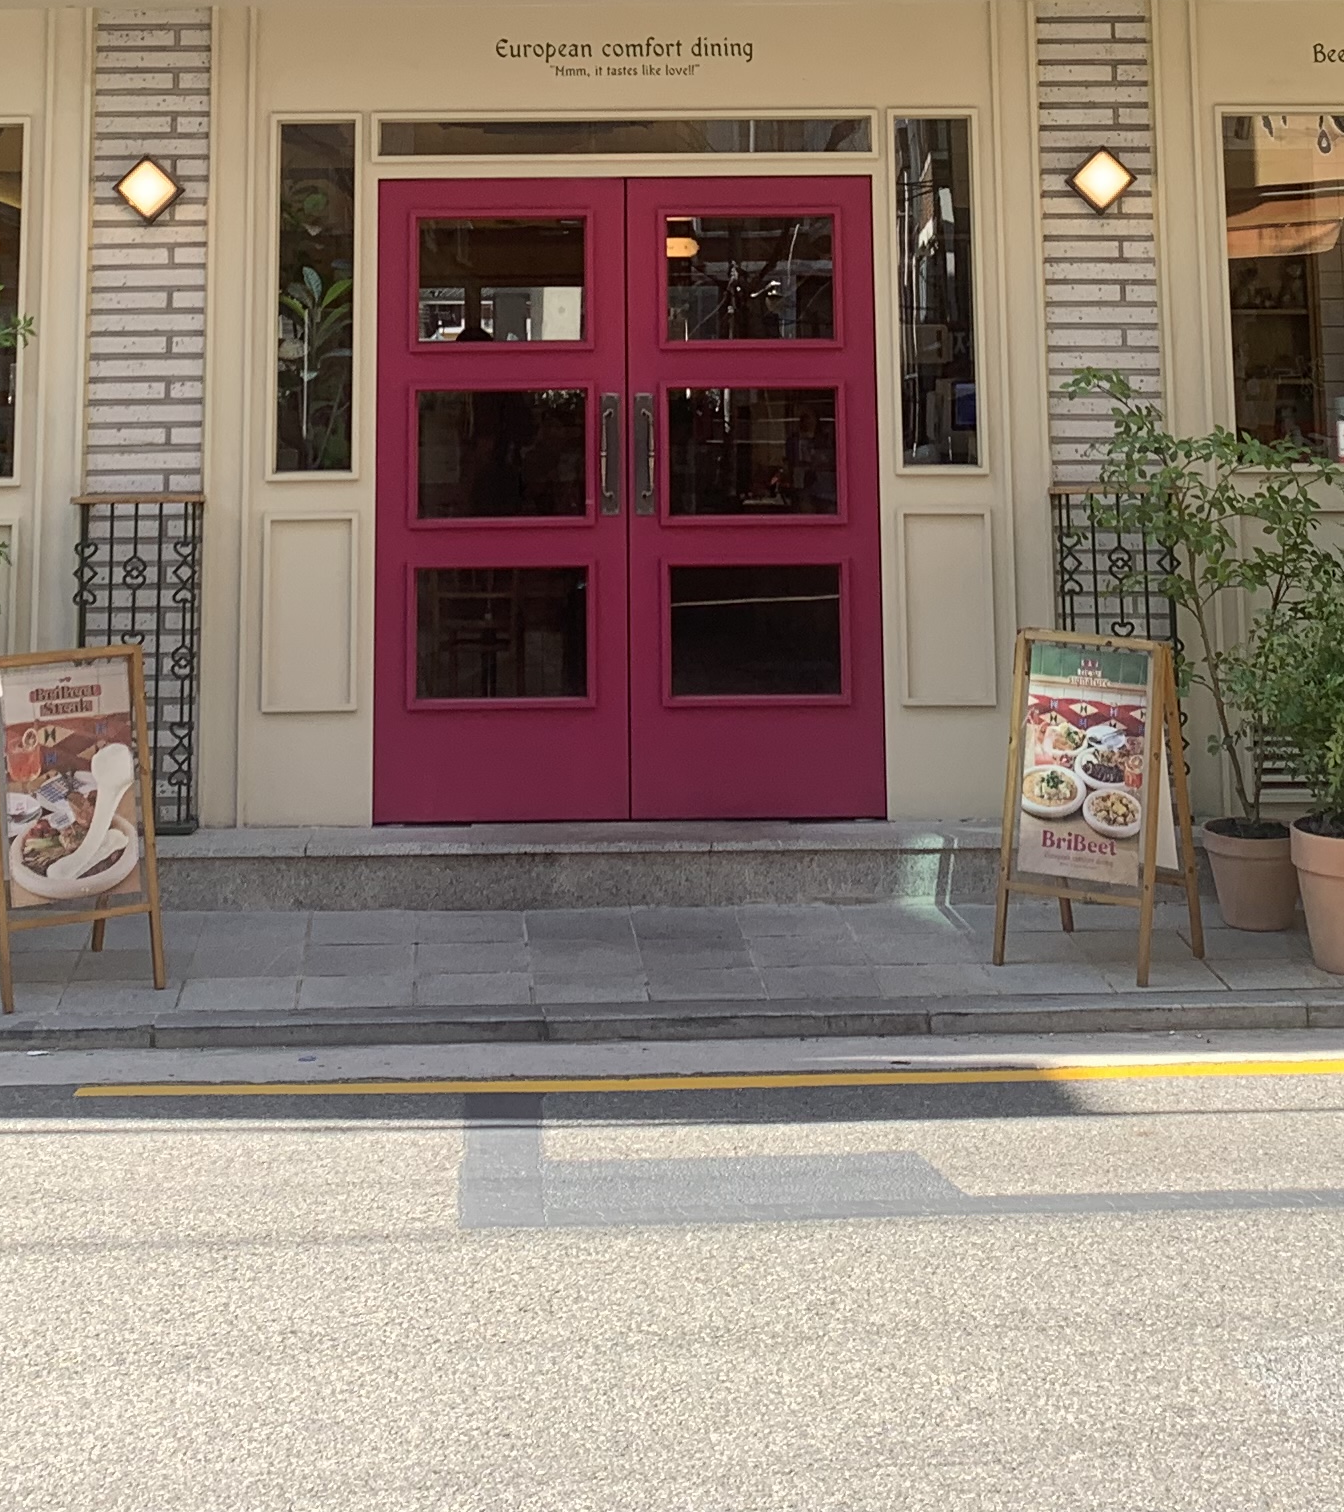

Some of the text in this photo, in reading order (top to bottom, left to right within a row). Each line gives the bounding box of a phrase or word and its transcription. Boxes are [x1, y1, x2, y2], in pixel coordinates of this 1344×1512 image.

[495, 36, 754, 63] European comfort dining
[595, 65, 603, 76] it
[606, 65, 639, 76] tastes
[641, 64, 662, 76] like
[1041, 829, 1117, 856] BriBeet
